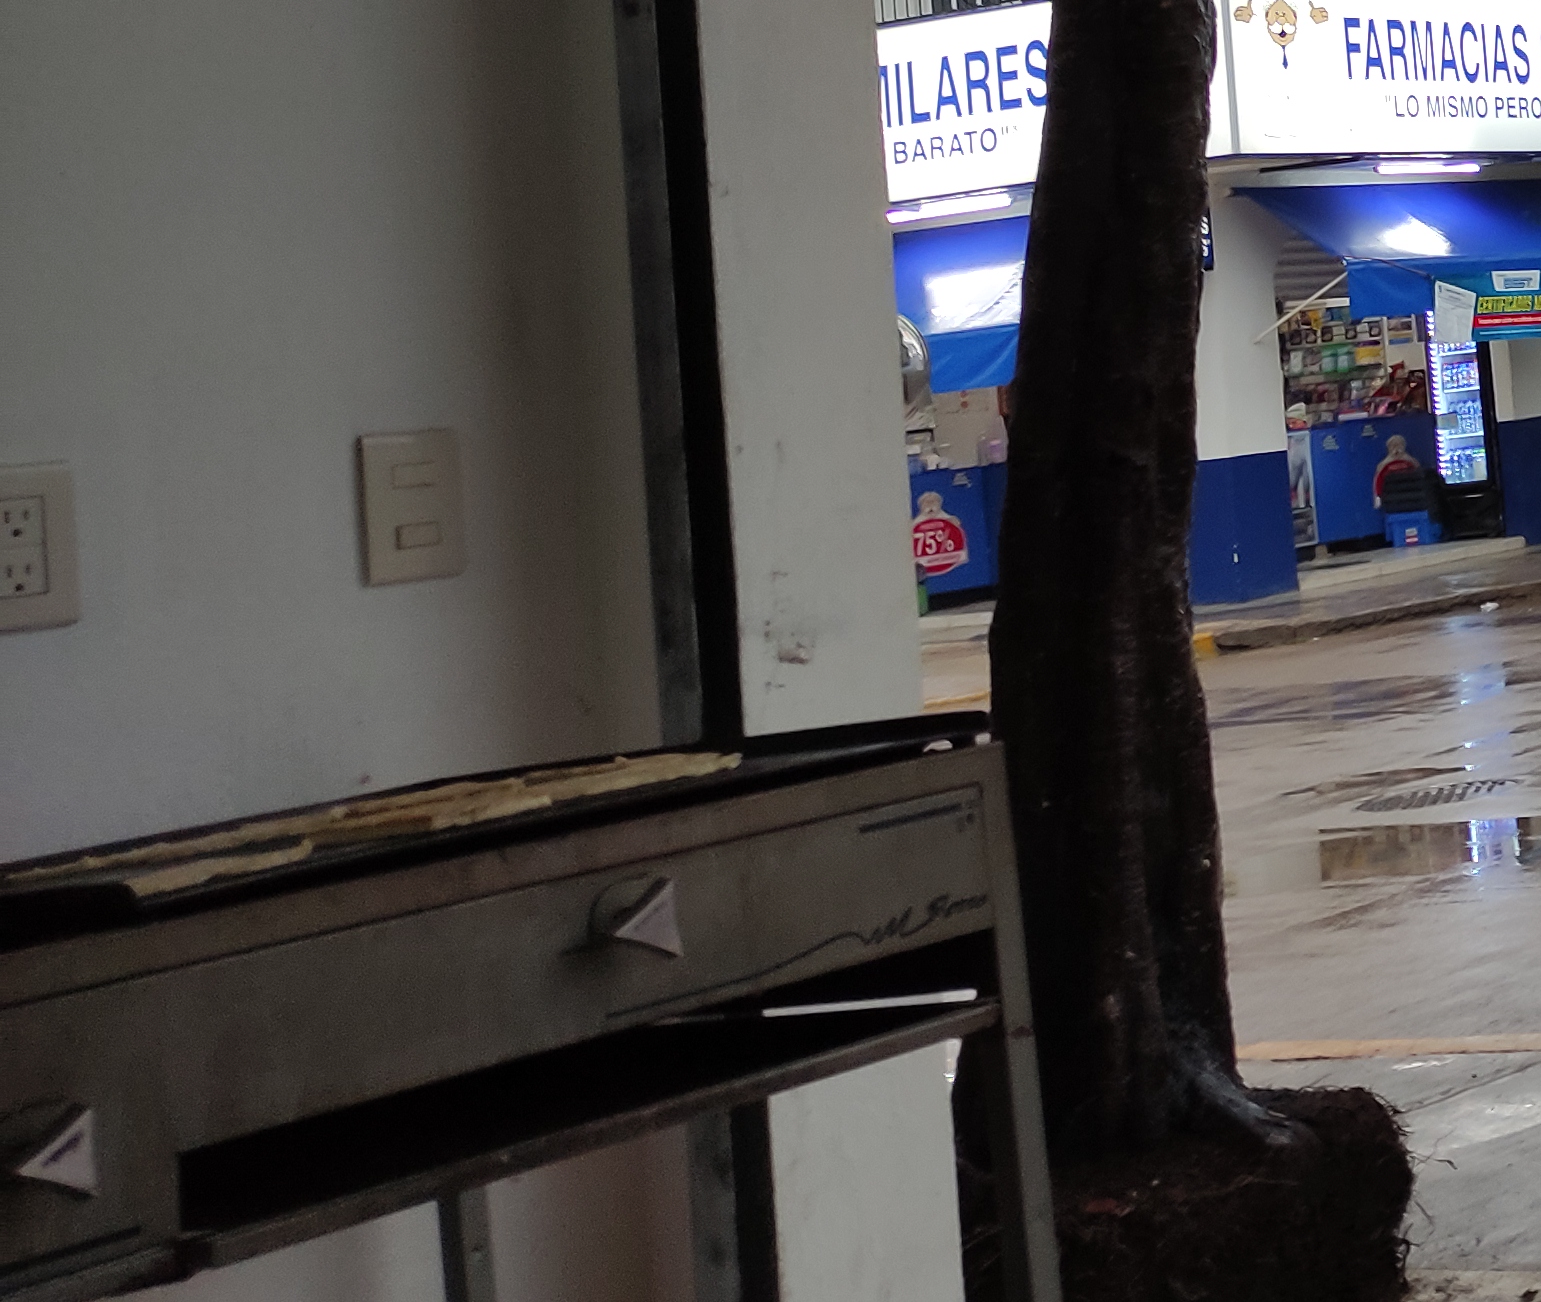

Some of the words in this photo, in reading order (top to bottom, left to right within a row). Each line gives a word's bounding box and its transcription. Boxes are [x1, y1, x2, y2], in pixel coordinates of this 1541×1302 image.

[1343, 17, 1531, 85] FARMACIAS
[1426, 95, 1488, 119] MISMO
[912, 529, 955, 557] 75%
